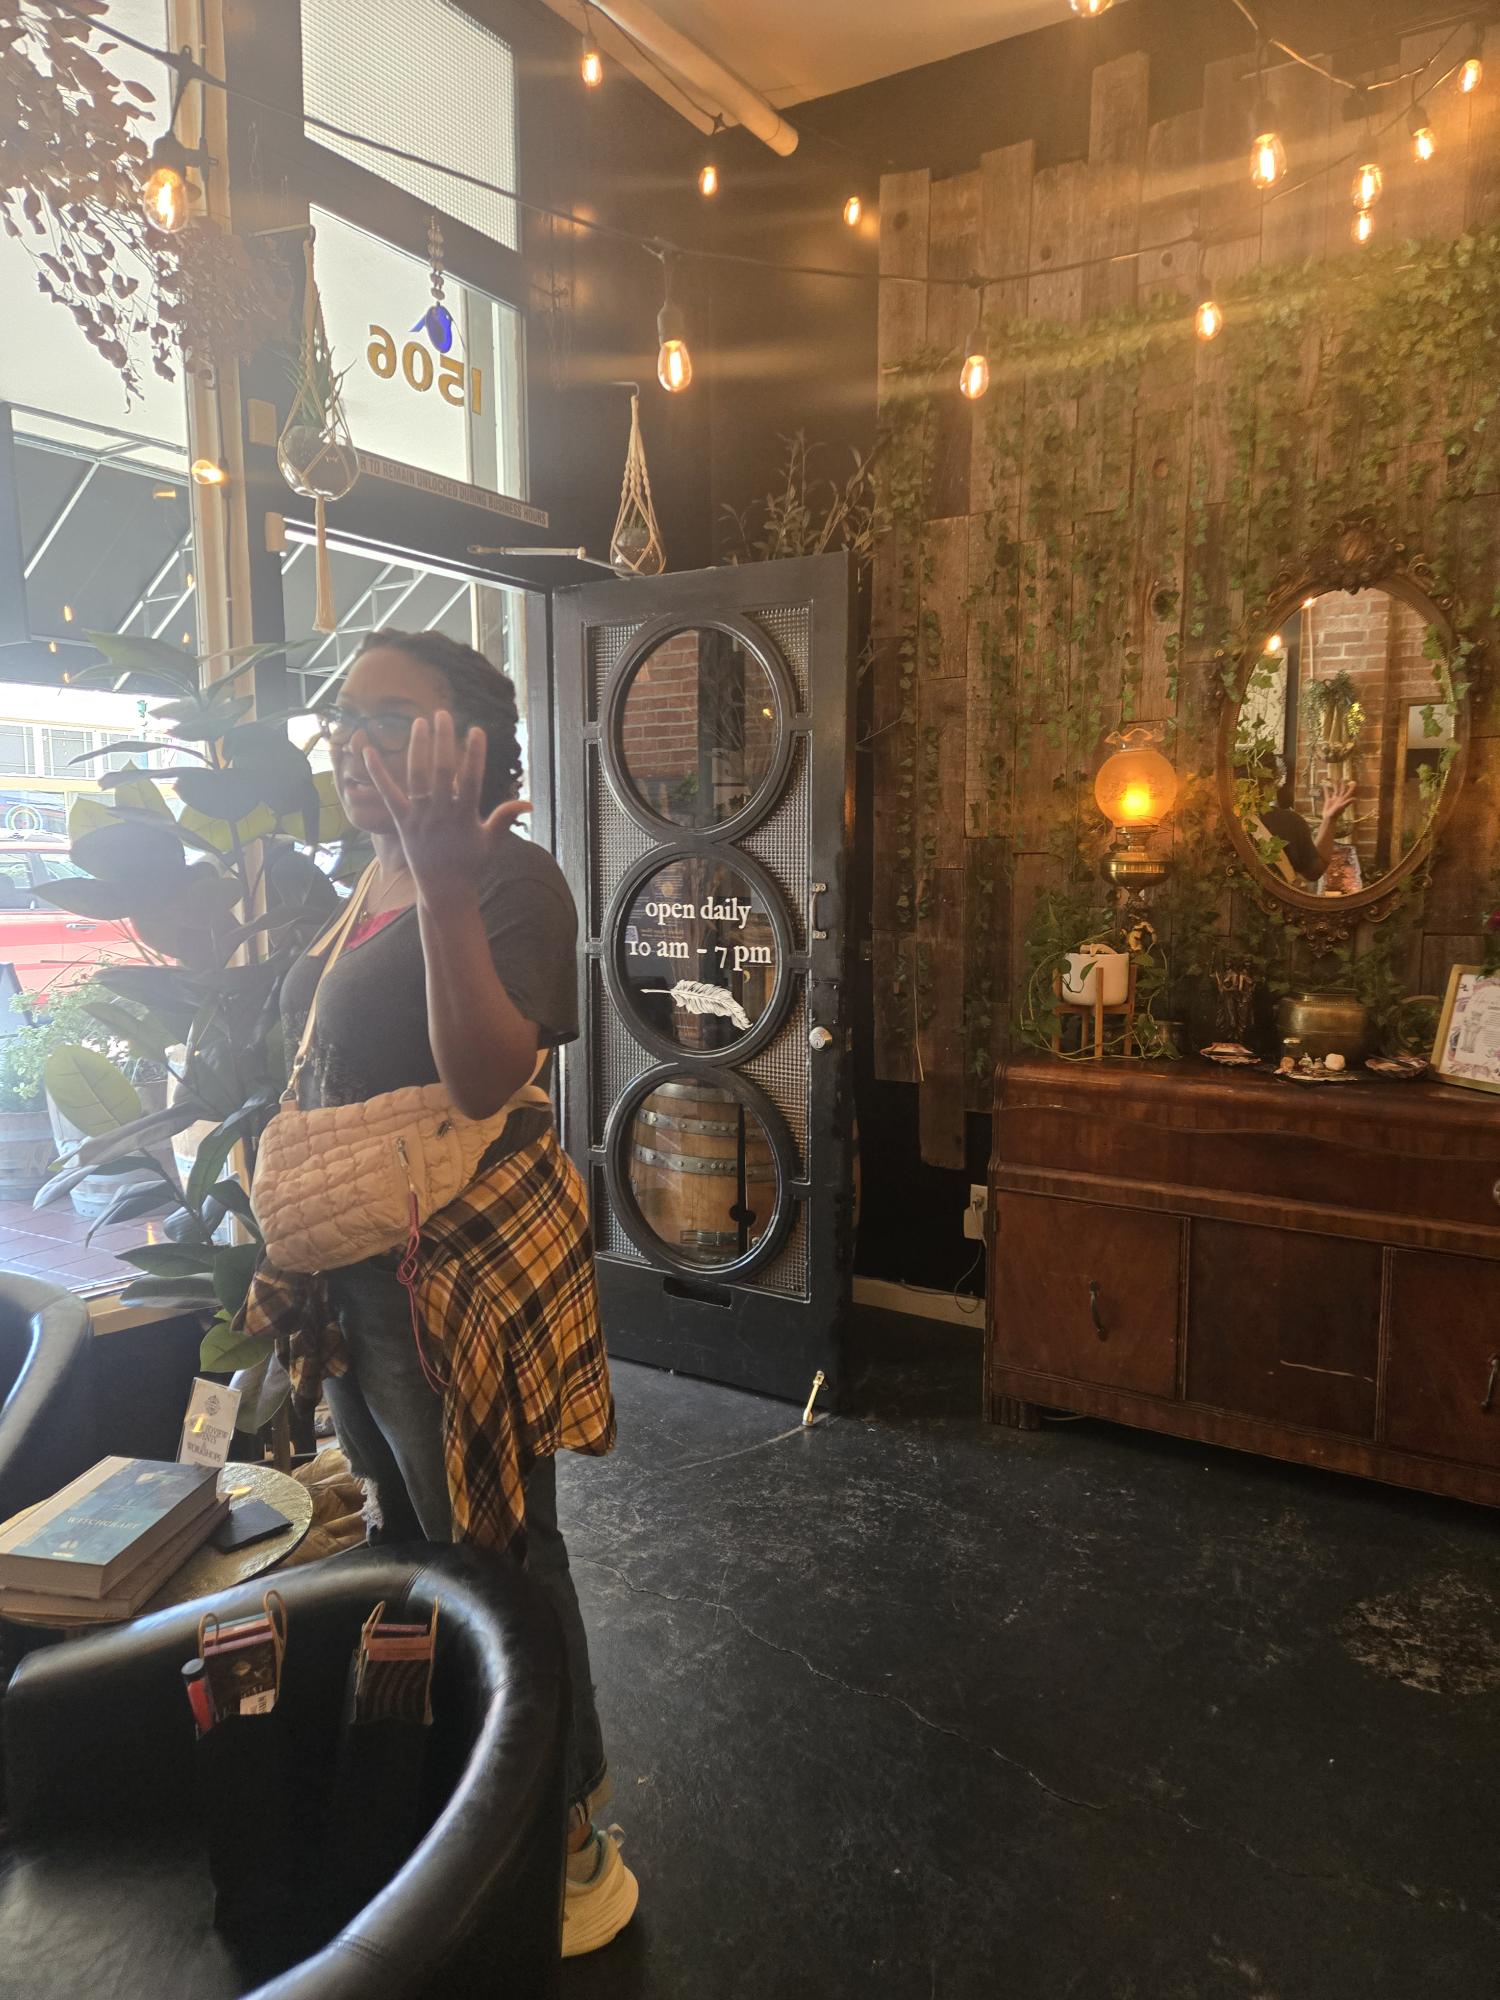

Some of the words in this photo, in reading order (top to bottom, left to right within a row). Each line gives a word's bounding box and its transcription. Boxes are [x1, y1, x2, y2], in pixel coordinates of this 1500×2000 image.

[368, 458, 381, 475] TO
[383, 462, 415, 484] REMAIN
[417, 471, 458, 498] UNLOCKED
[460, 485, 487, 507] DURING
[489, 495, 521, 517] BUSINESS
[524, 507, 546, 525] HOURS
[645, 901, 695, 925] open
[701, 896, 752, 929] daily
[629, 941, 651, 956] 10
[657, 941, 689, 958] am
[715, 946, 728, 968] 7
[733, 945, 772, 971] pm
